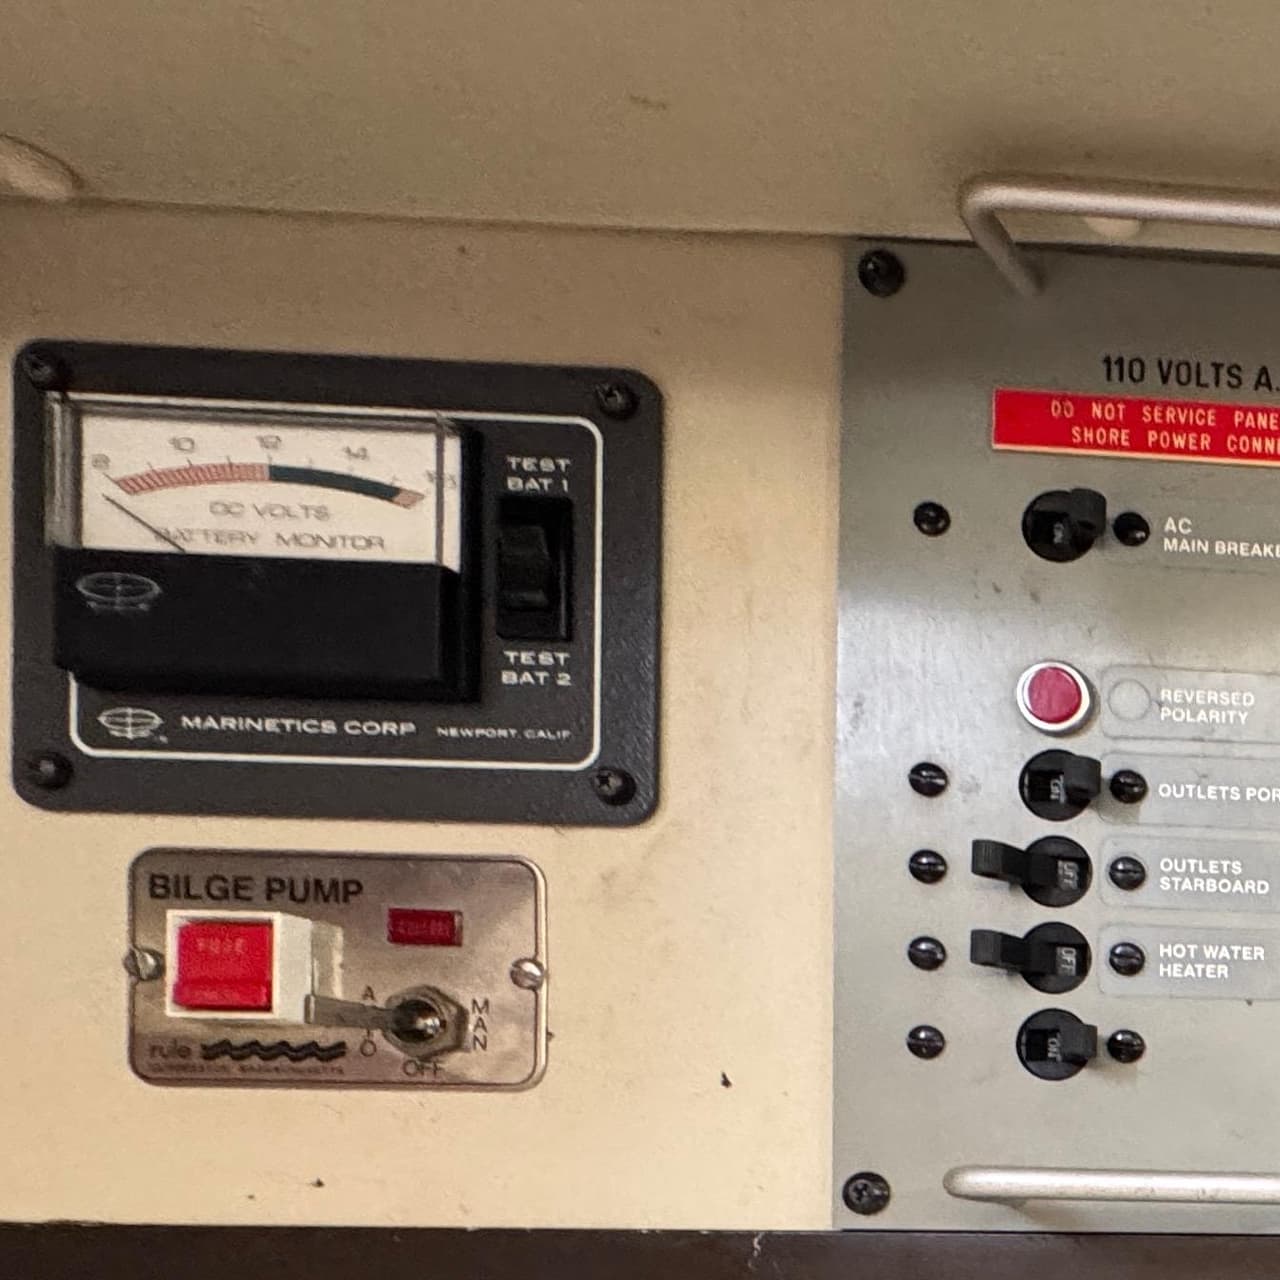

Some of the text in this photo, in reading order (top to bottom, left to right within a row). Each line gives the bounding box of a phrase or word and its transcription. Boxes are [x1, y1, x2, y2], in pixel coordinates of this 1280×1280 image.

[1102, 355, 1146, 385] 110
[1157, 358, 1243, 390] VOLTS
[1051, 399, 1075, 420] DO
[1092, 402, 1126, 422] NOT
[1142, 405, 1217, 427] SERVICE
[169, 436, 195, 451] 10
[256, 435, 282, 450] 12
[1071, 426, 1131, 447] SHORE
[1147, 430, 1212, 452] POWER
[506, 455, 571, 473] TEST
[506, 476, 569, 493] BAT 1
[209, 501, 331, 522] DC VOLTS
[1164, 517, 1193, 534] AC
[153, 527, 385, 551] BATTERY MONITOR
[1163, 537, 1209, 554] MAIN
[503, 651, 571, 666] TEST
[501, 671, 572, 687] BAT 2
[1160, 688, 1255, 706] REVERSED
[180, 715, 337, 735] MARINETICS
[344, 719, 416, 736] CORP
[1160, 708, 1248, 725] POLARITY
[1158, 783, 1241, 801] OUTLETS
[1159, 858, 1243, 874] OUTLETS
[148, 872, 365, 906] BILGE PUMP
[1159, 877, 1270, 895] STARBOARD
[1159, 943, 1265, 961] HOT WATER
[1159, 962, 1229, 979] HEATER
